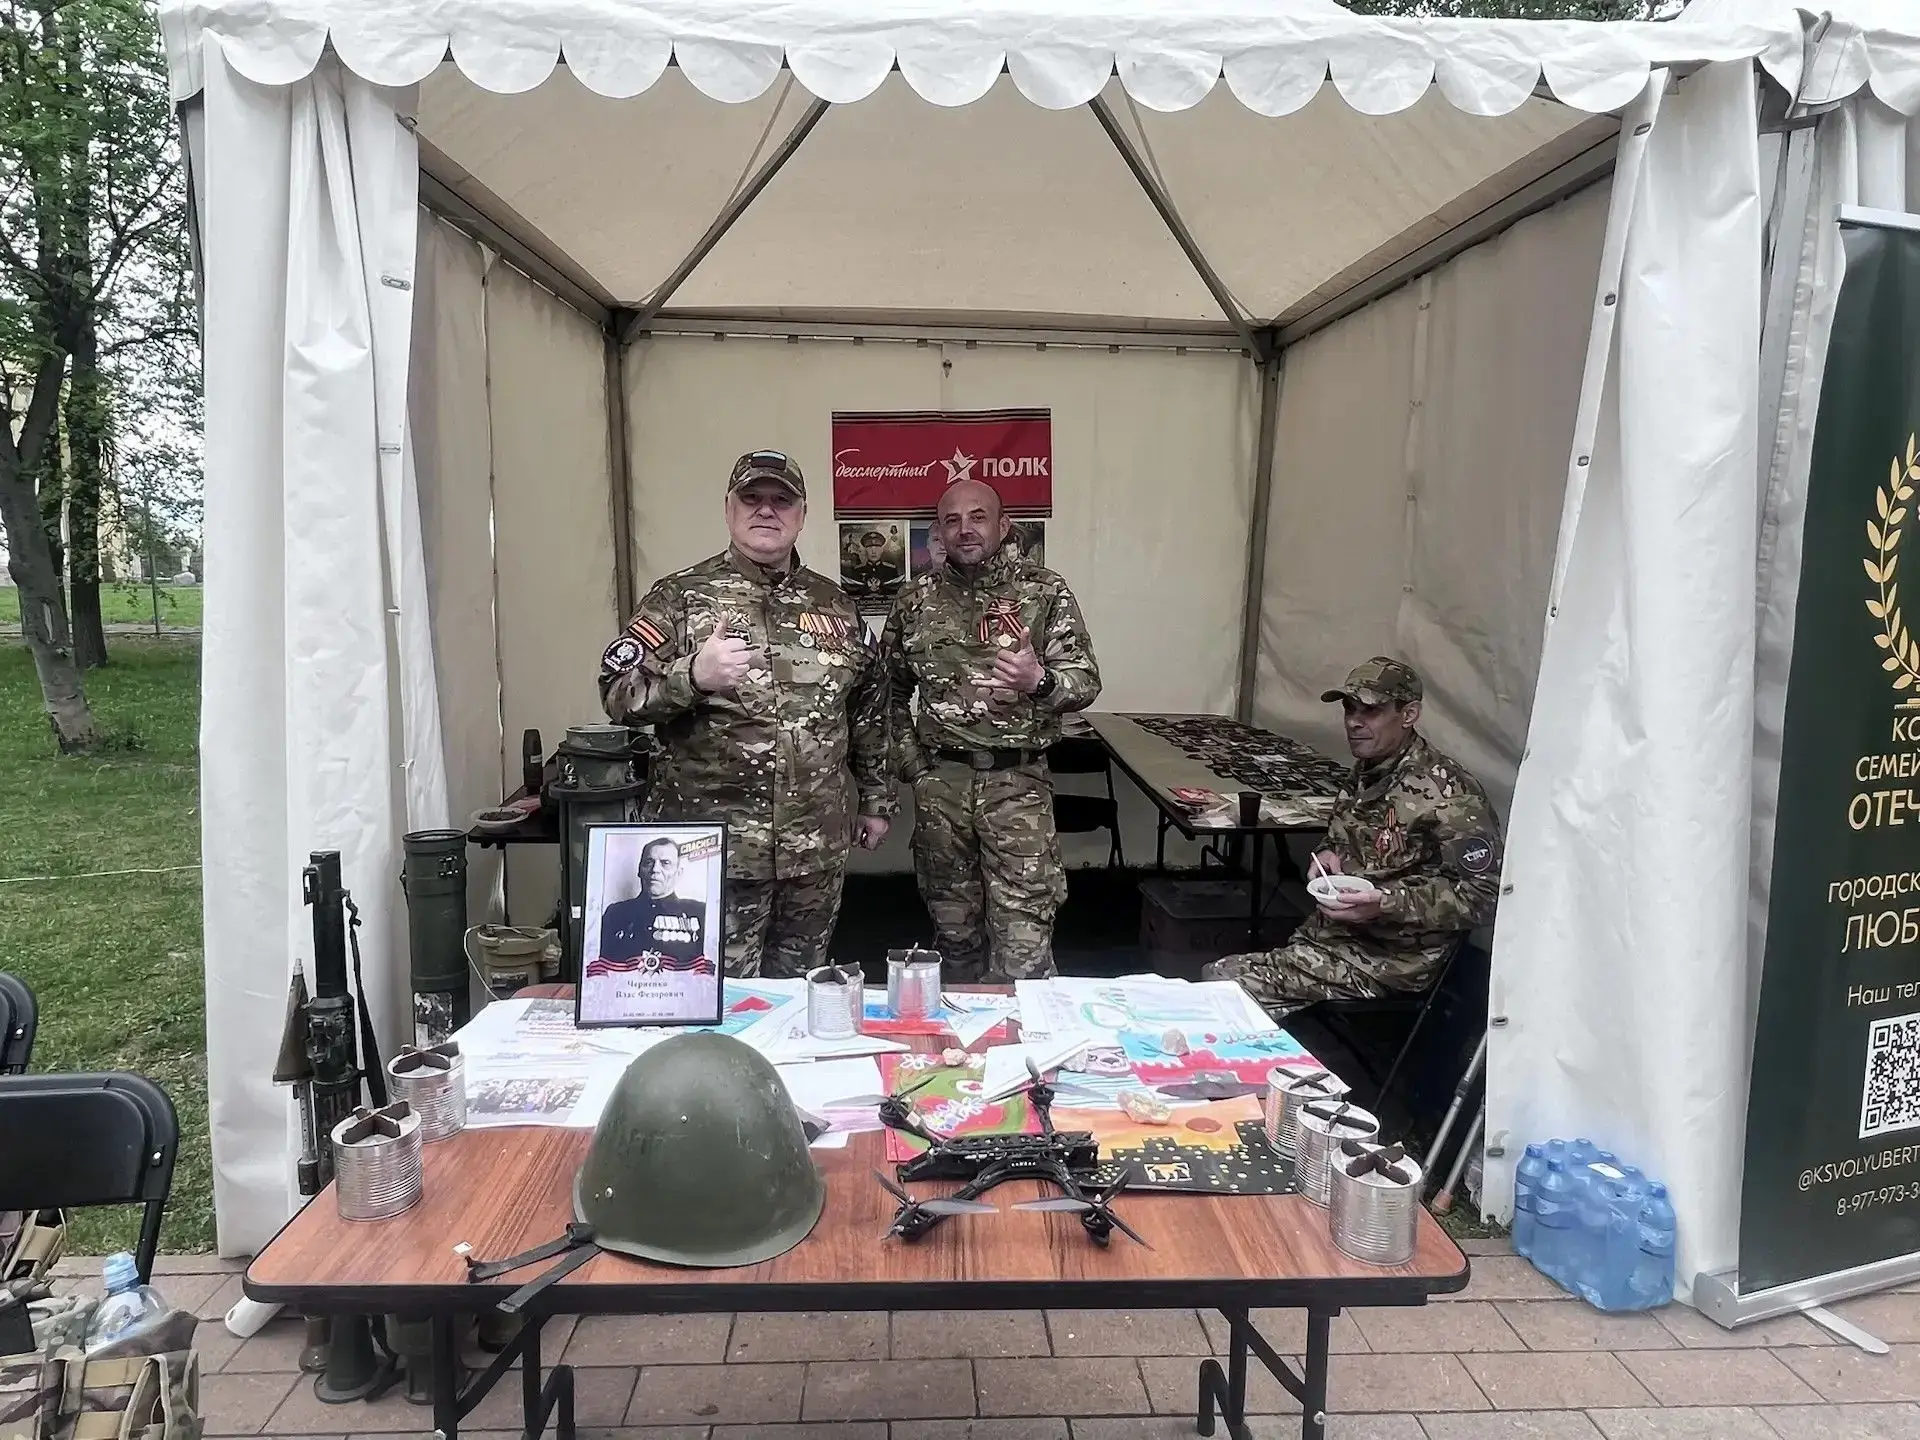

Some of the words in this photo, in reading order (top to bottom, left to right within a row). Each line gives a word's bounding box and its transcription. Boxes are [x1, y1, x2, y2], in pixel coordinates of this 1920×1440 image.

[835, 448, 937, 482] бессмертный
[982, 456, 1049, 478] ПОЛК
[1848, 789, 1920, 831] ОТЕЧ
[1841, 907, 1920, 953] ЛЮБ
[1847, 985, 1890, 1007] Наш
[1798, 1144, 1920, 1192] @KSVOLYUBERT
[1836, 1181, 1920, 1216] 8-977-973-3
